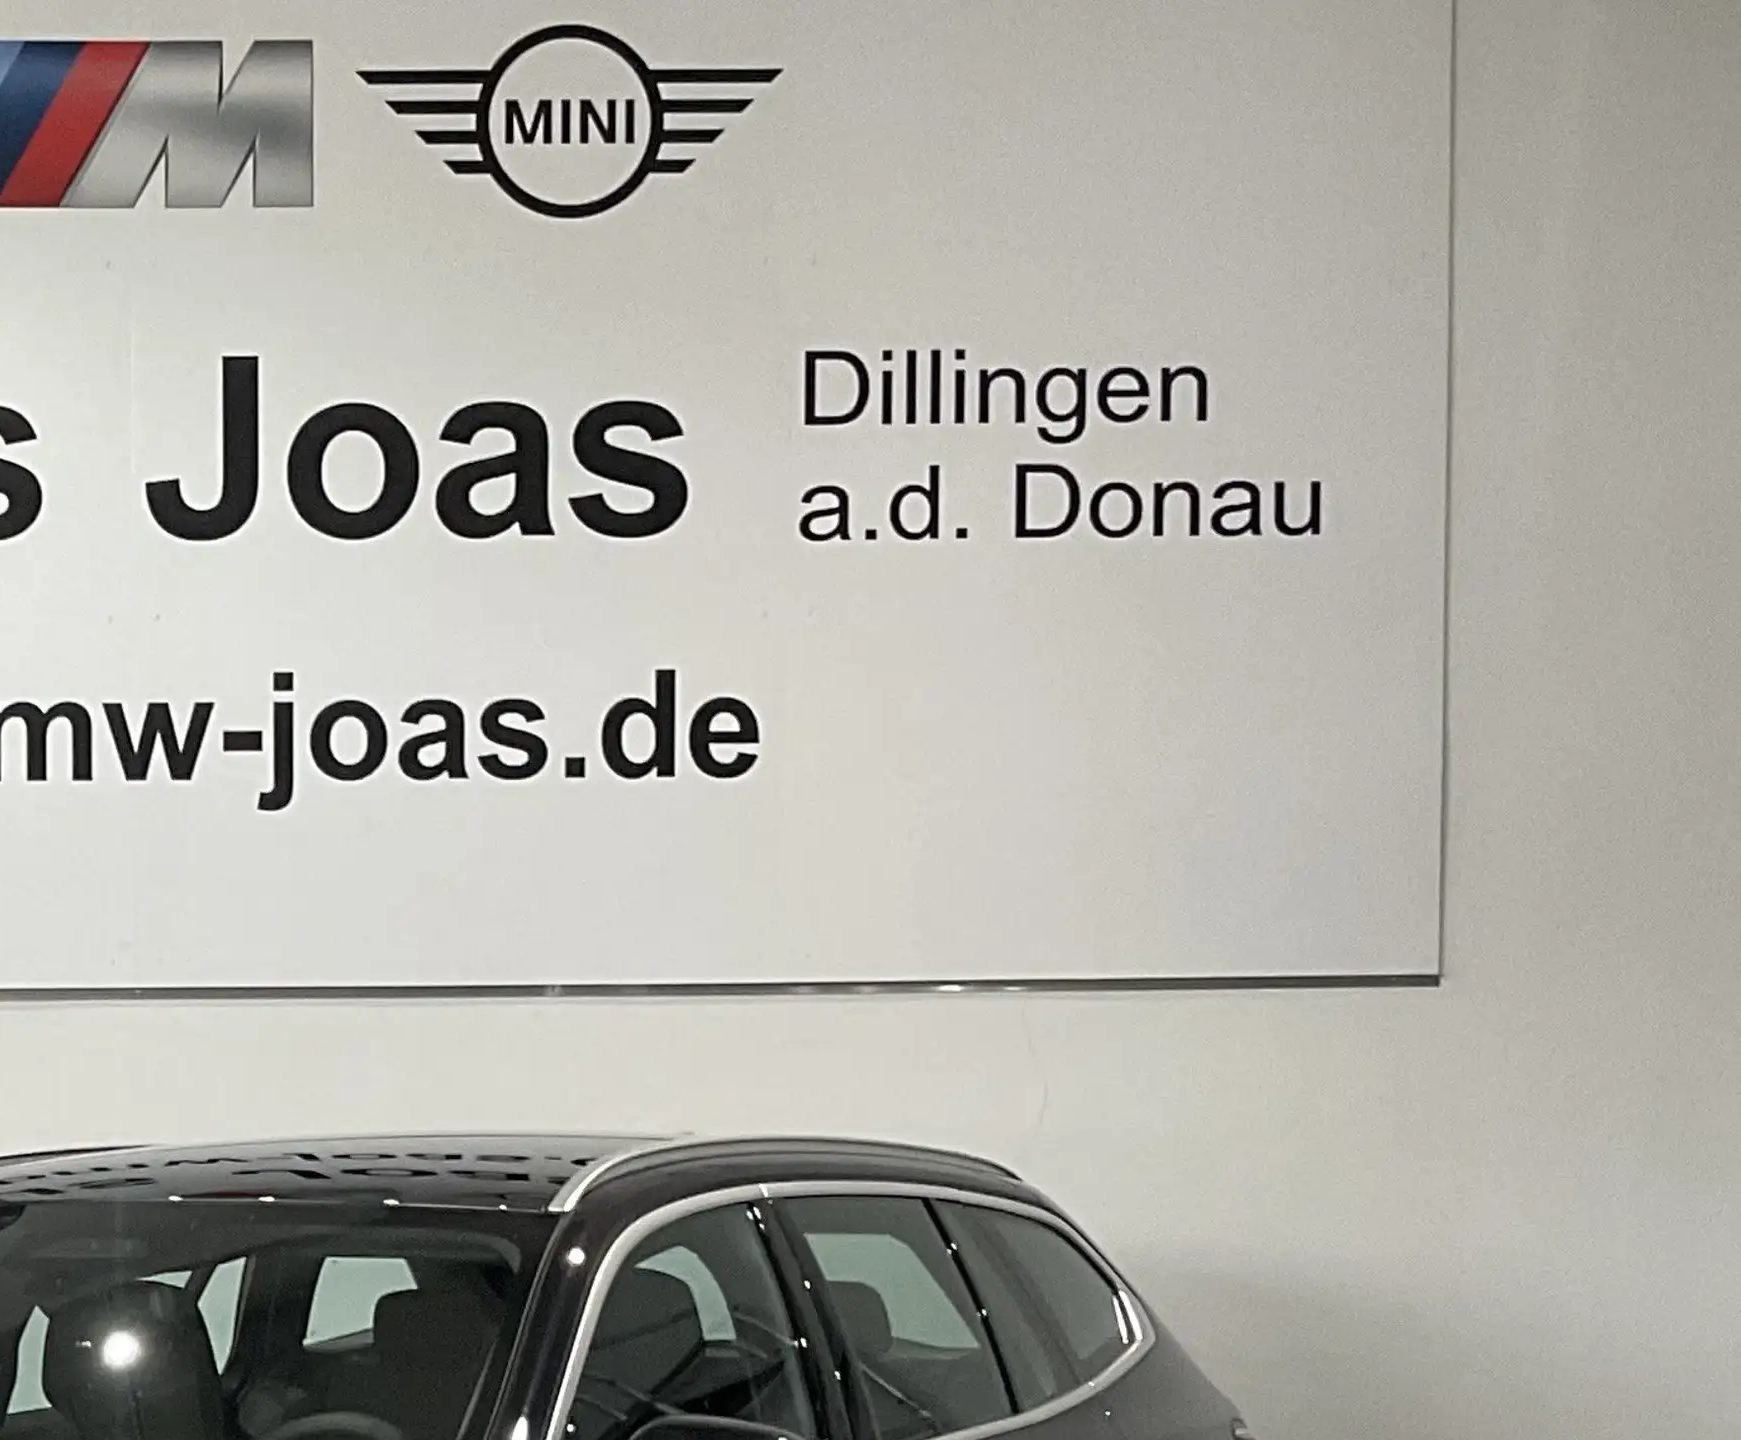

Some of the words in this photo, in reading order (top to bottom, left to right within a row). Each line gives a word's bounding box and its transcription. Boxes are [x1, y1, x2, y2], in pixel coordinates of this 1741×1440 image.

[504, 97, 637, 146] MINI
[803, 347, 1209, 446] Dillingen
[144, 354, 689, 543] Joas
[798, 463, 969, 543] a.d.
[1014, 462, 1322, 540] Donau
